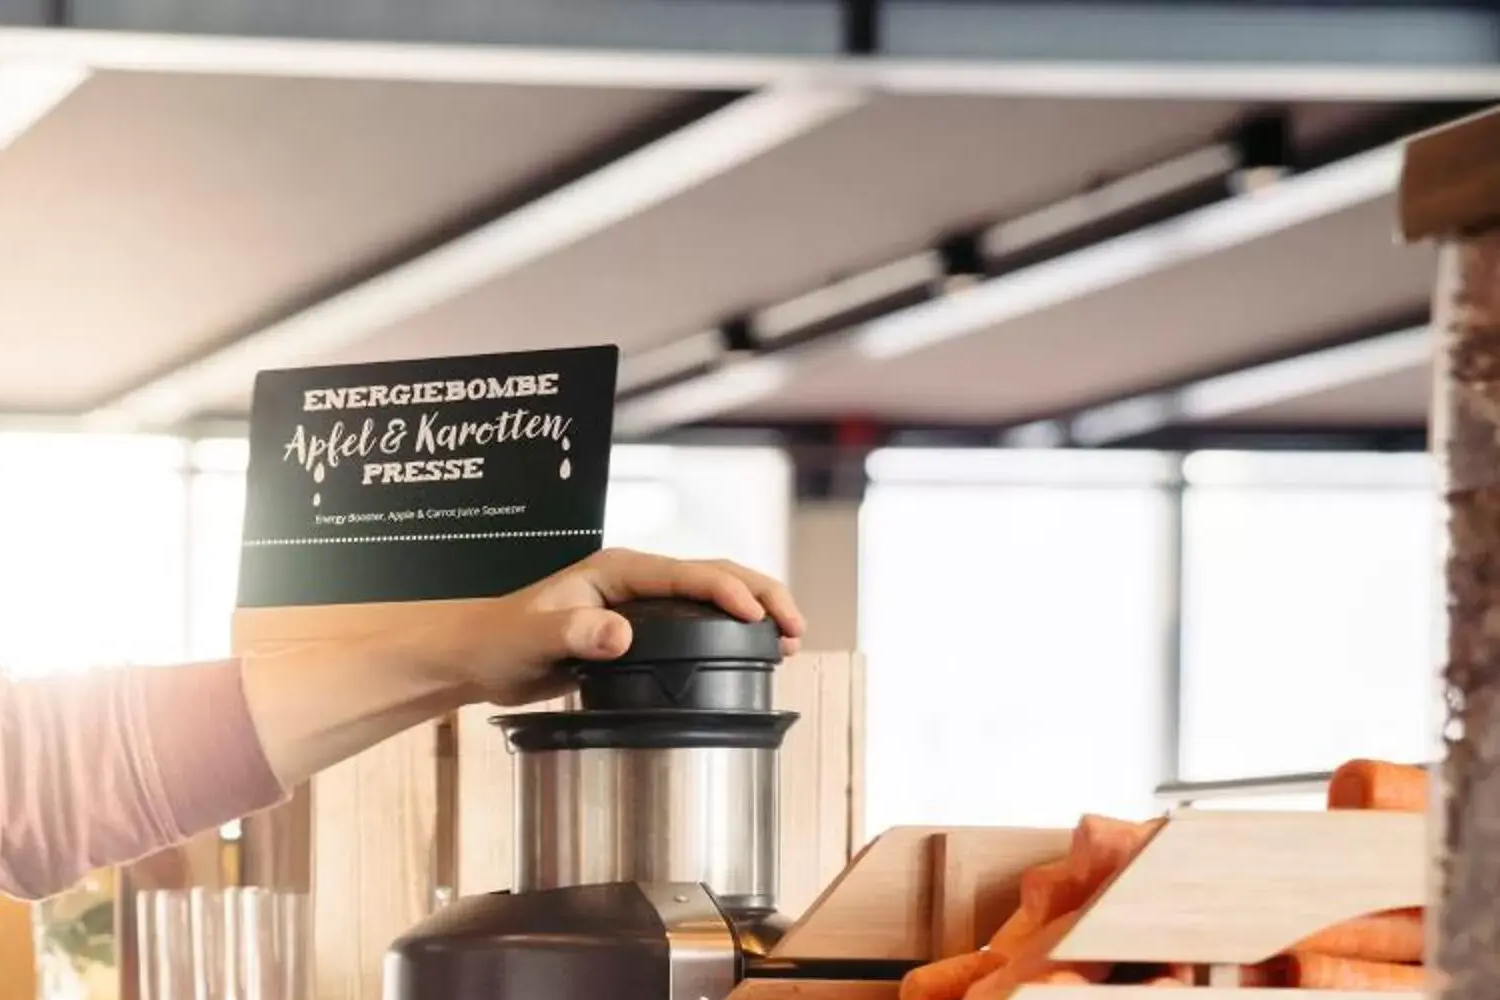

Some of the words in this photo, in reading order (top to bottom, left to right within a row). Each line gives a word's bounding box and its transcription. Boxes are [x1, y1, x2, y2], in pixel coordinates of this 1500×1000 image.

[303, 374, 559, 411] ENERGIEBOMBE
[283, 418, 376, 472] Apfel
[380, 418, 408, 455] &
[415, 408, 573, 455] Karotten
[361, 457, 485, 485] PRESSE
[315, 514, 347, 525] Energy
[388, 510, 415, 522] Apple
[417, 509, 425, 519] &
[426, 507, 456, 519] Carrot
[482, 504, 527, 516] Squeezer
